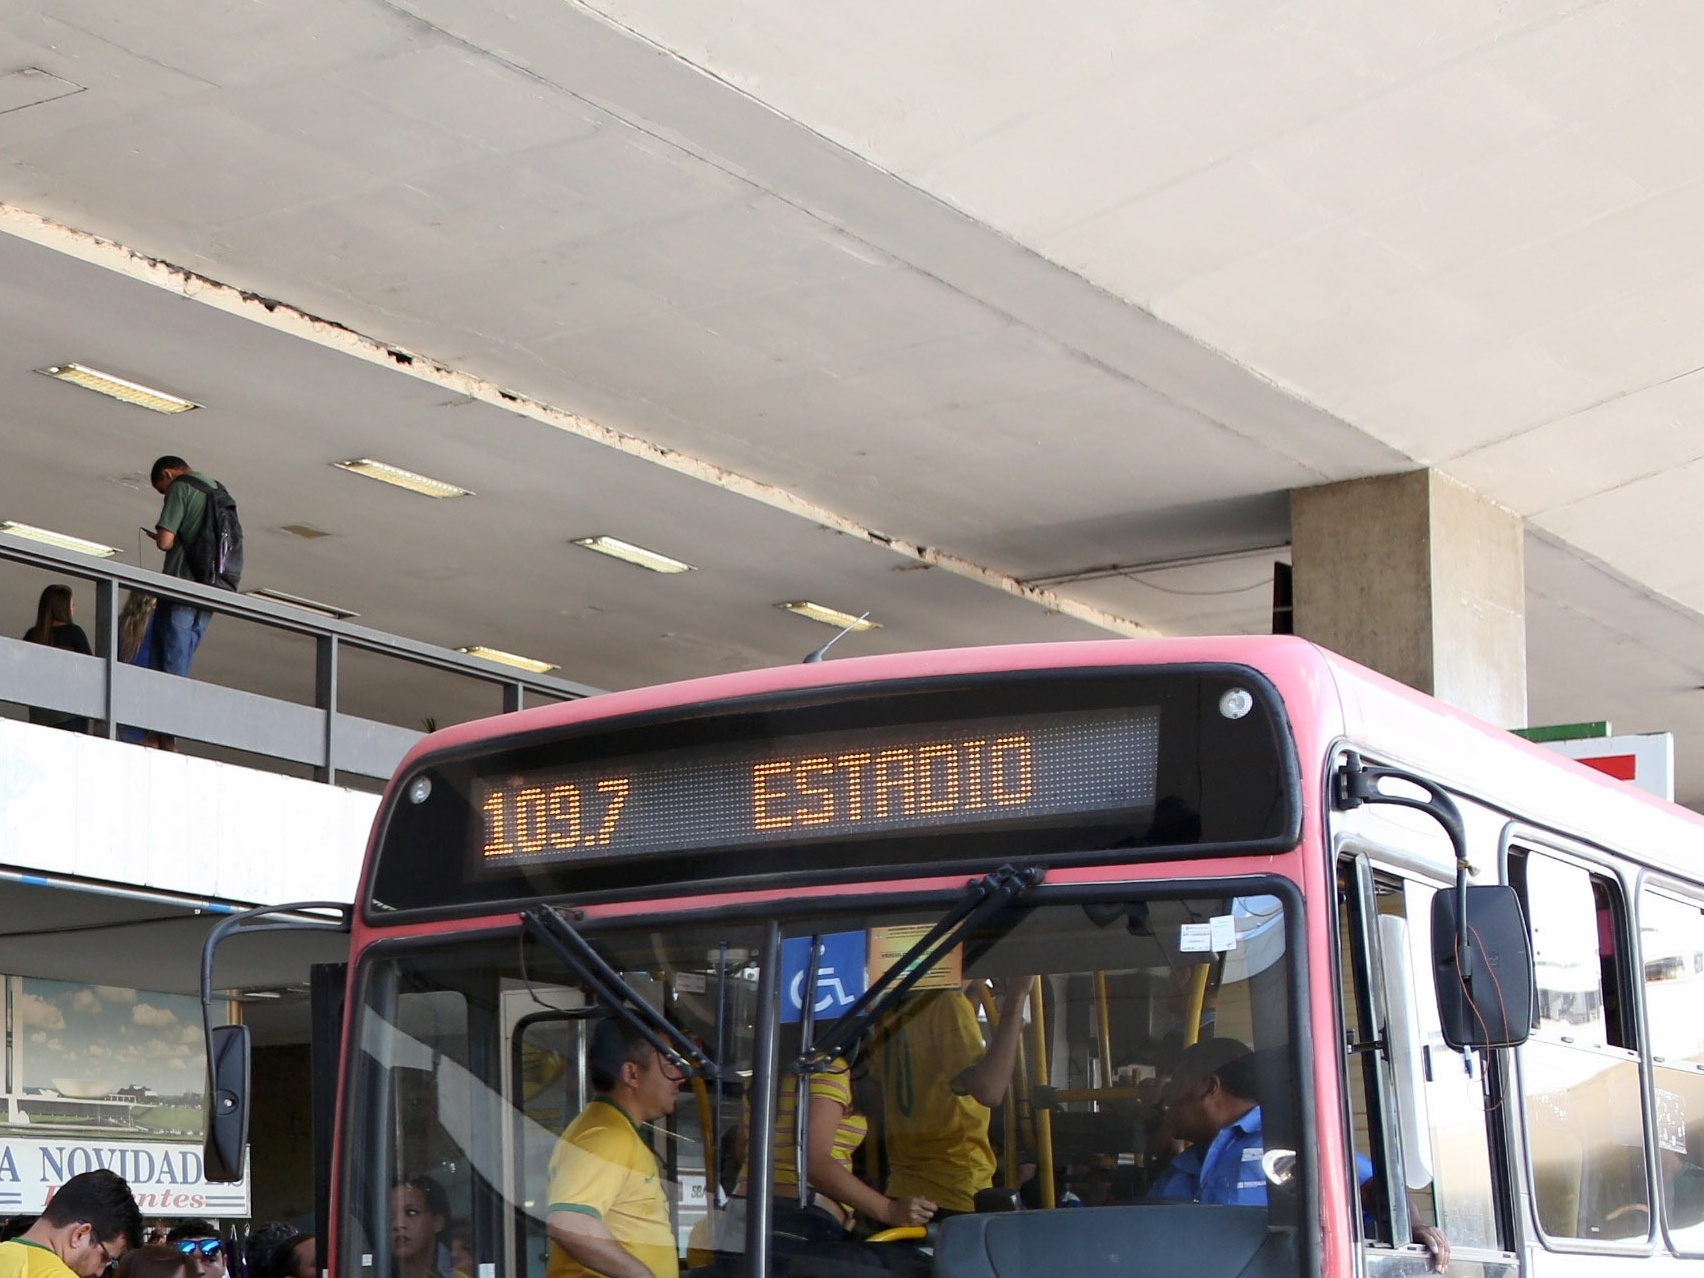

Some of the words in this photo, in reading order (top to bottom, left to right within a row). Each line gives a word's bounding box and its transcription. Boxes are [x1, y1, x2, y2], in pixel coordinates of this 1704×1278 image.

[482, 778, 630, 858] 109.7
[752, 736, 1032, 830] ESTADIO
[39, 1146, 244, 1188] NOVIDAD
